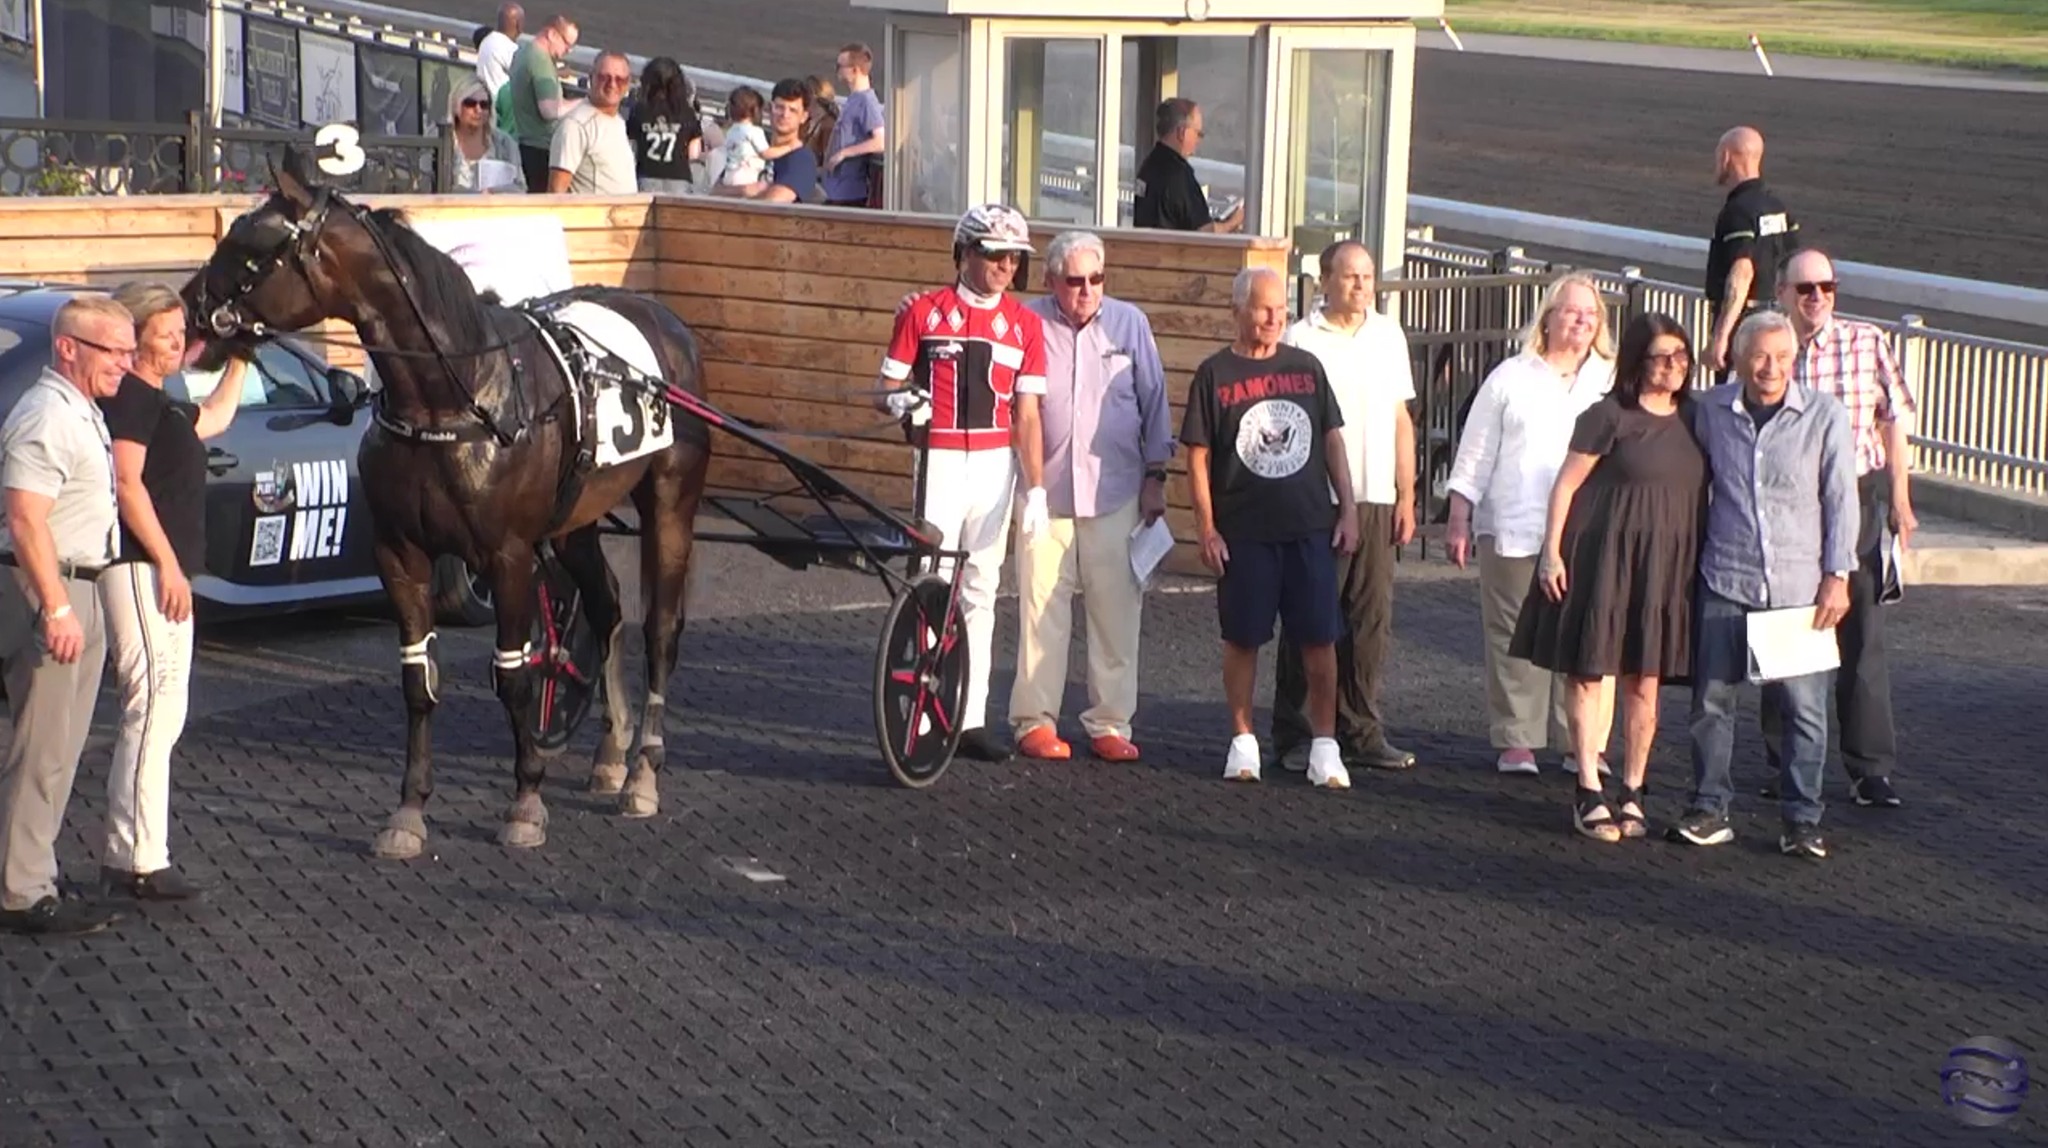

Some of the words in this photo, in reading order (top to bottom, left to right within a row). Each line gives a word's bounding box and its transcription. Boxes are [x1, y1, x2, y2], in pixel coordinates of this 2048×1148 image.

[315, 124, 366, 175] 3
[646, 132, 677, 162] 27
[600, 355, 646, 456] 3
[1218, 375, 1315, 406] RAMONES
[292, 459, 348, 508] WIN
[289, 506, 347, 561] ME!
